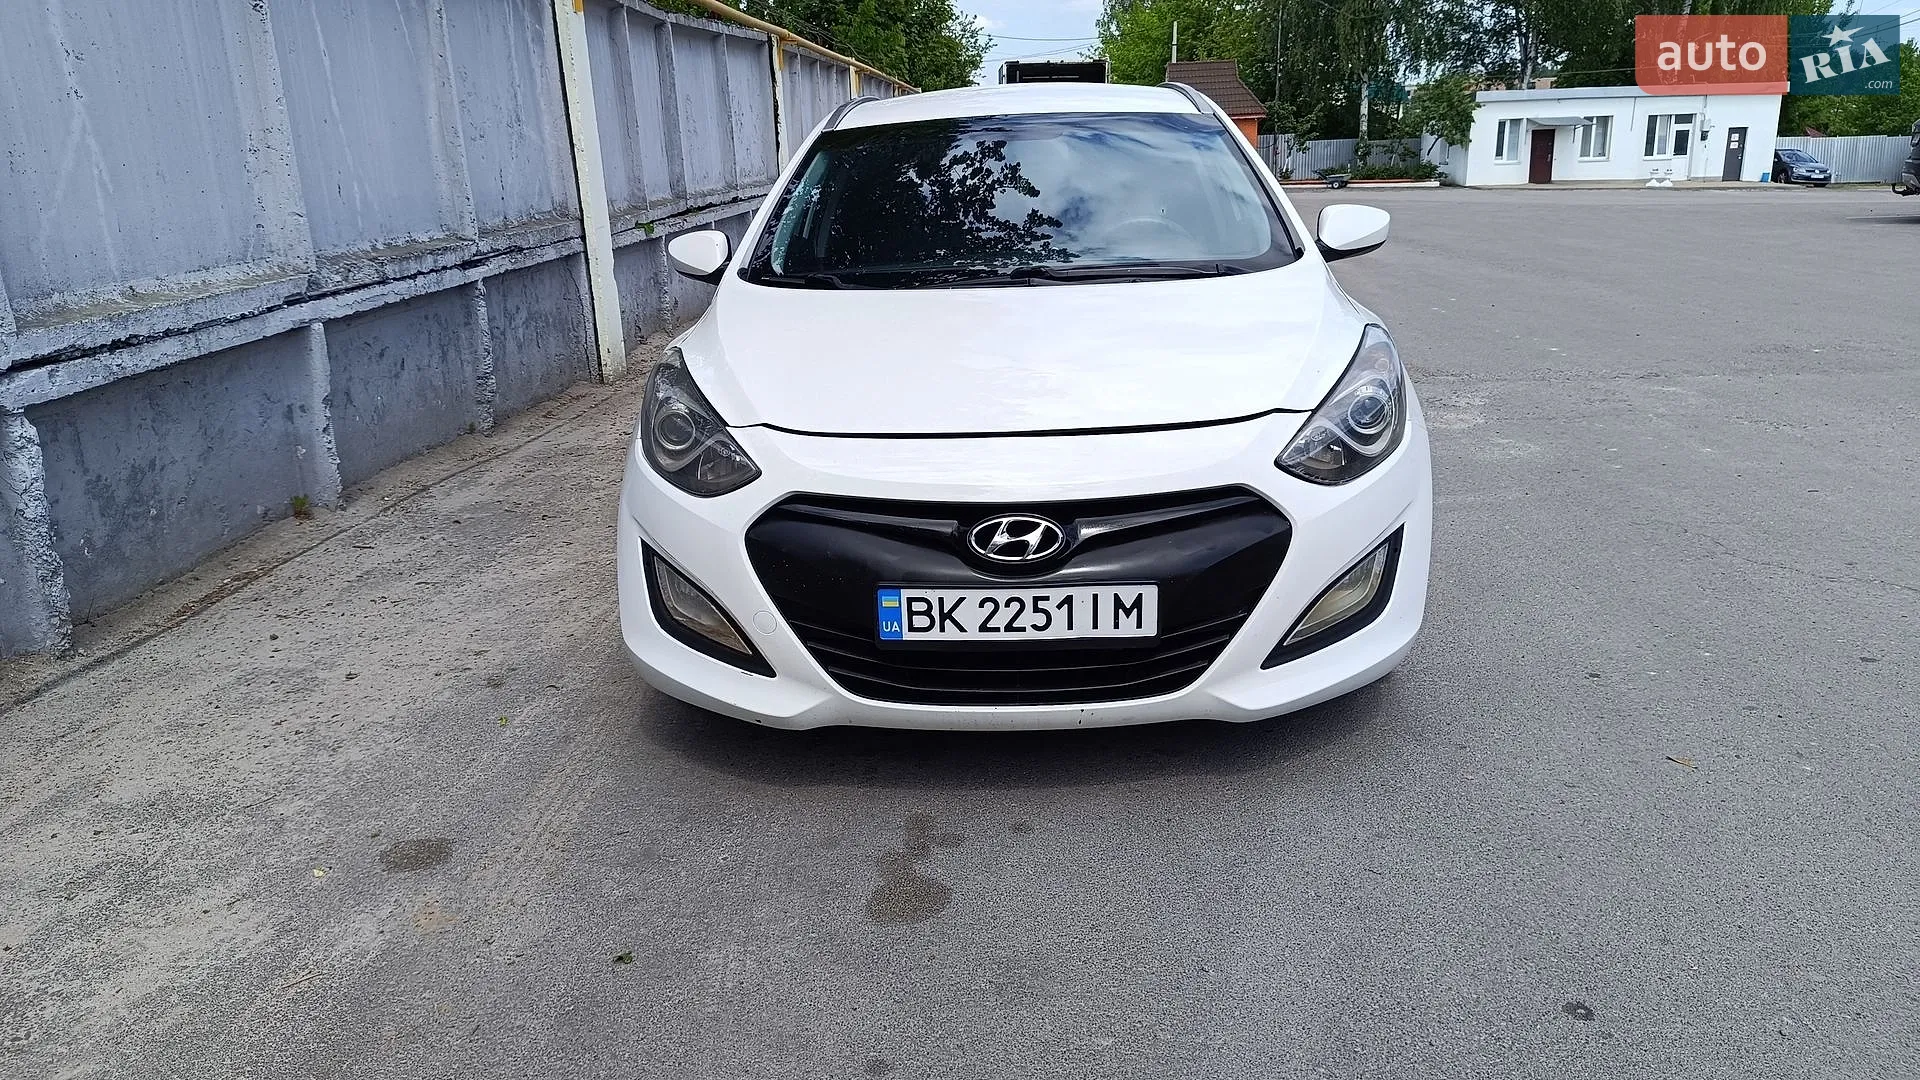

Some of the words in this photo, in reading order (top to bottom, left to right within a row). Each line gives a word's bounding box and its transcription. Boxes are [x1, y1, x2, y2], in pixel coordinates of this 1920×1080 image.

[905, 596, 969, 633] BK
[977, 594, 1075, 633] 2251
[1091, 592, 1144, 631] IM
[882, 621, 900, 633] UA
